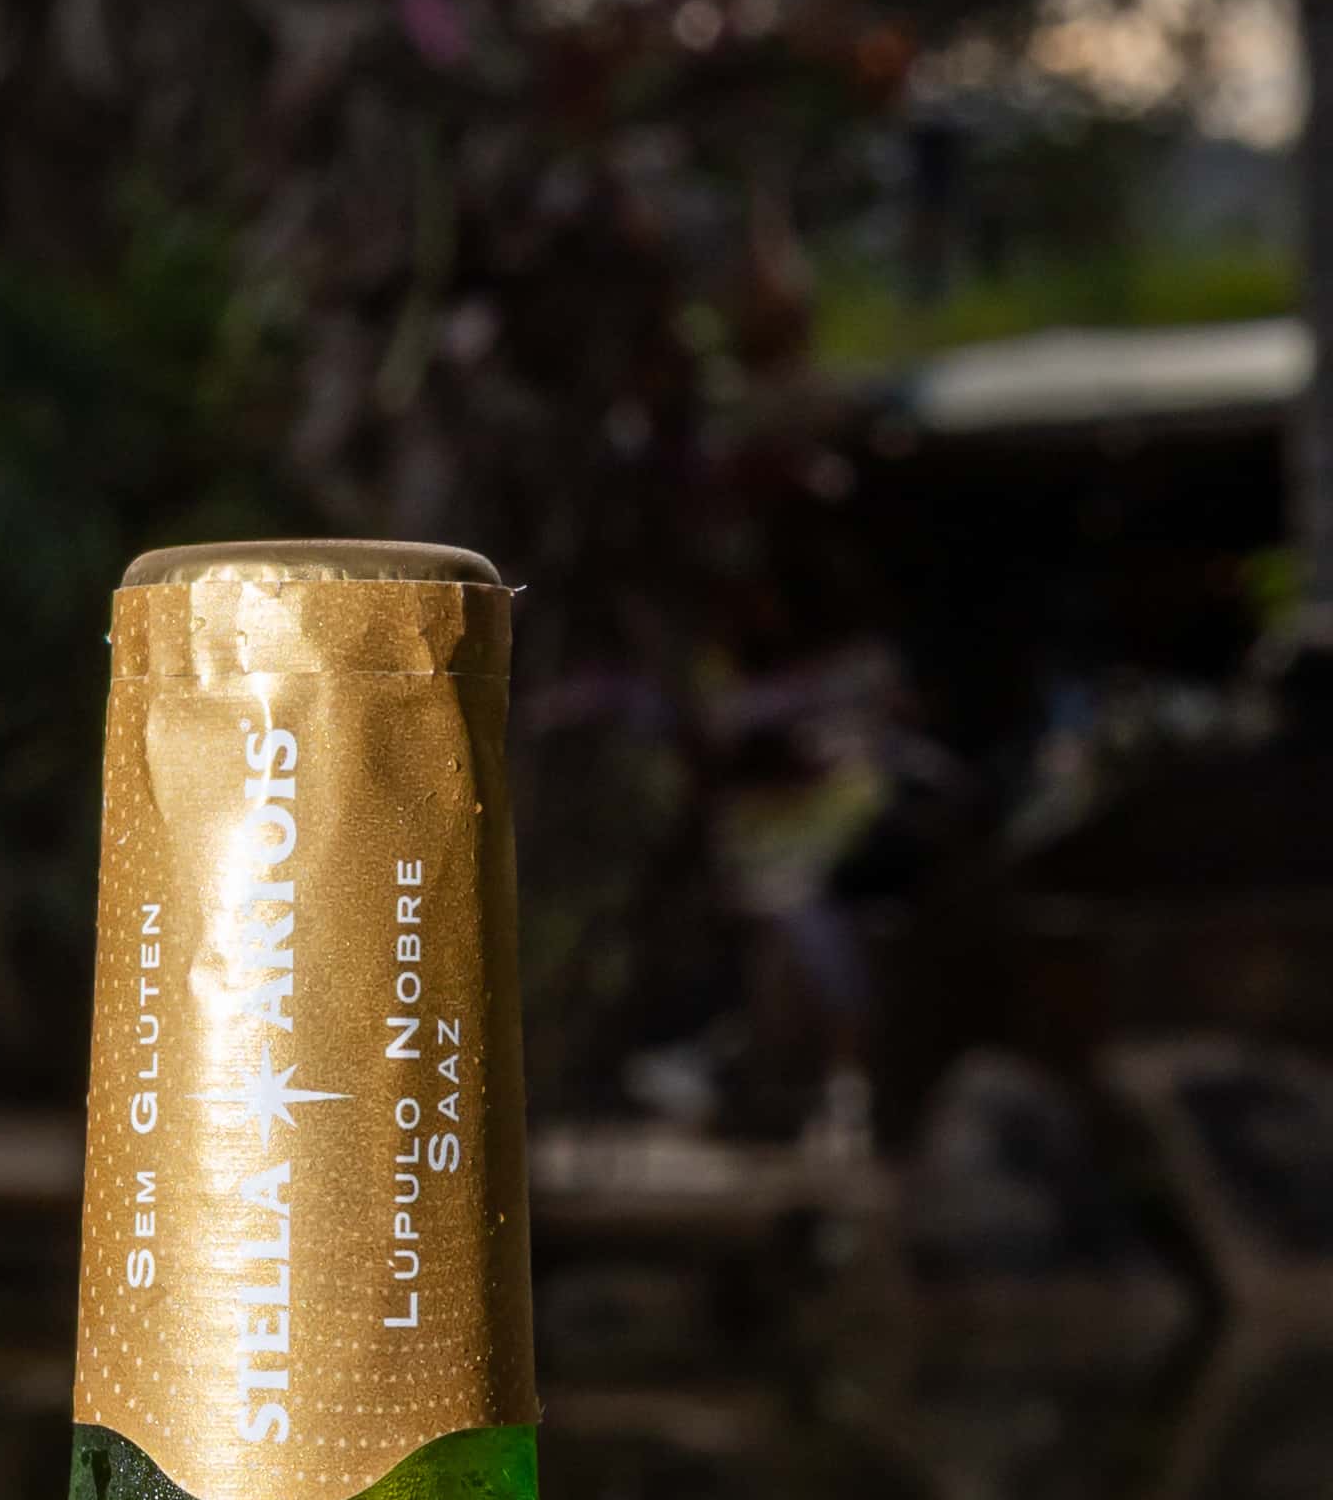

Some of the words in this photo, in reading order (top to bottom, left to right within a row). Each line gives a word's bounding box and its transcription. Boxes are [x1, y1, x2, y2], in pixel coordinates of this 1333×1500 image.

[242, 729, 298, 1033] ARTOIS
[385, 860, 423, 1060] NOBRE
[428, 1018, 460, 1173] SAAZ
[127, 1171, 156, 1288] SEM
[236, 1159, 291, 1444] STELLA
[383, 1097, 420, 1327] LÚPULO
